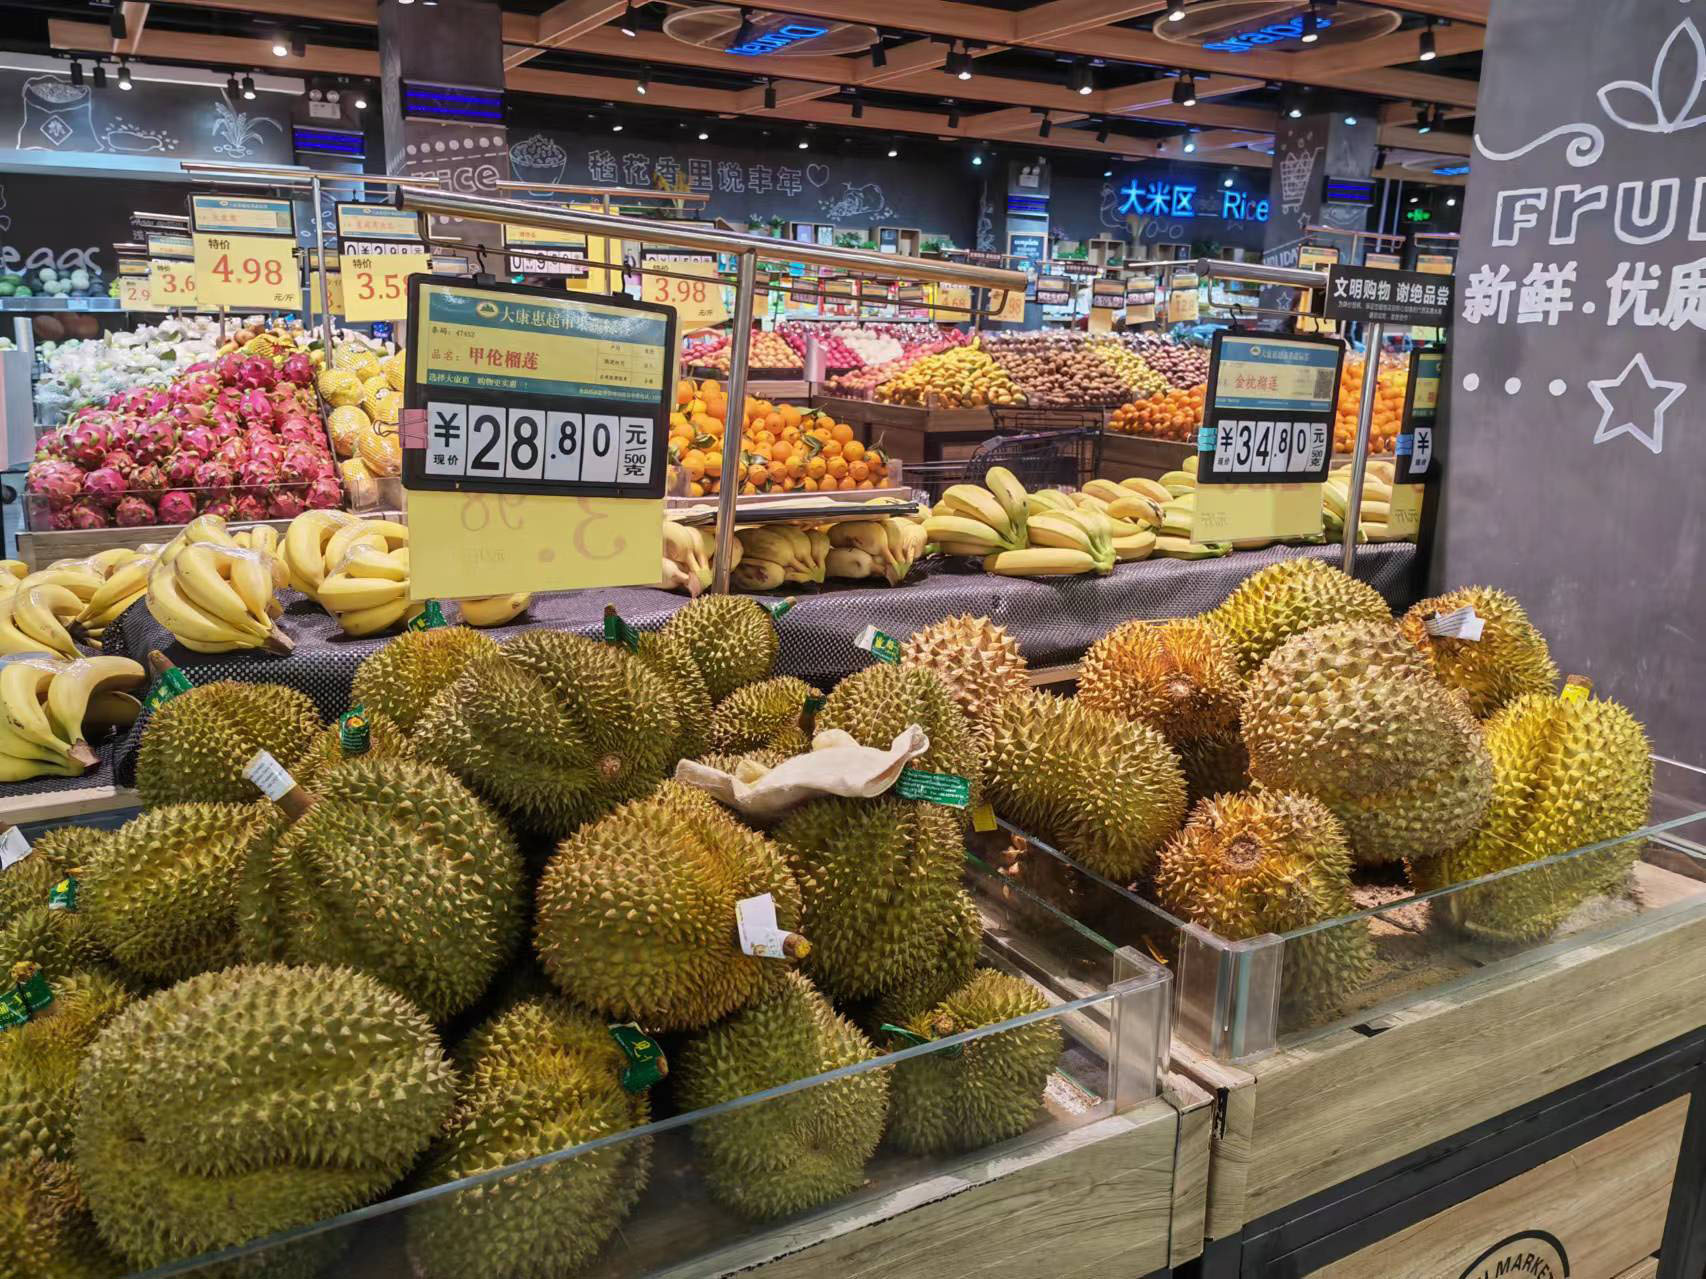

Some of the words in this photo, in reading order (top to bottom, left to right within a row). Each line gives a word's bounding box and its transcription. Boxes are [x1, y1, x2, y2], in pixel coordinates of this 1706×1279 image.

[588, 150, 802, 197] 稻花香里说丰年
[1118, 179, 1197, 217] 大米区
[1223, 190, 1270, 222] Rice
[208, 238, 230, 250] 特价
[212, 254, 284, 286] 4.98
[655, 277, 706, 304] 3.98
[1334, 276, 1391, 302] 文明购物
[1396, 281, 1450, 307] 谢绝品尝
[469, 346, 540, 371] 甲伦榴莲
[433, 453, 459, 466] 现价
